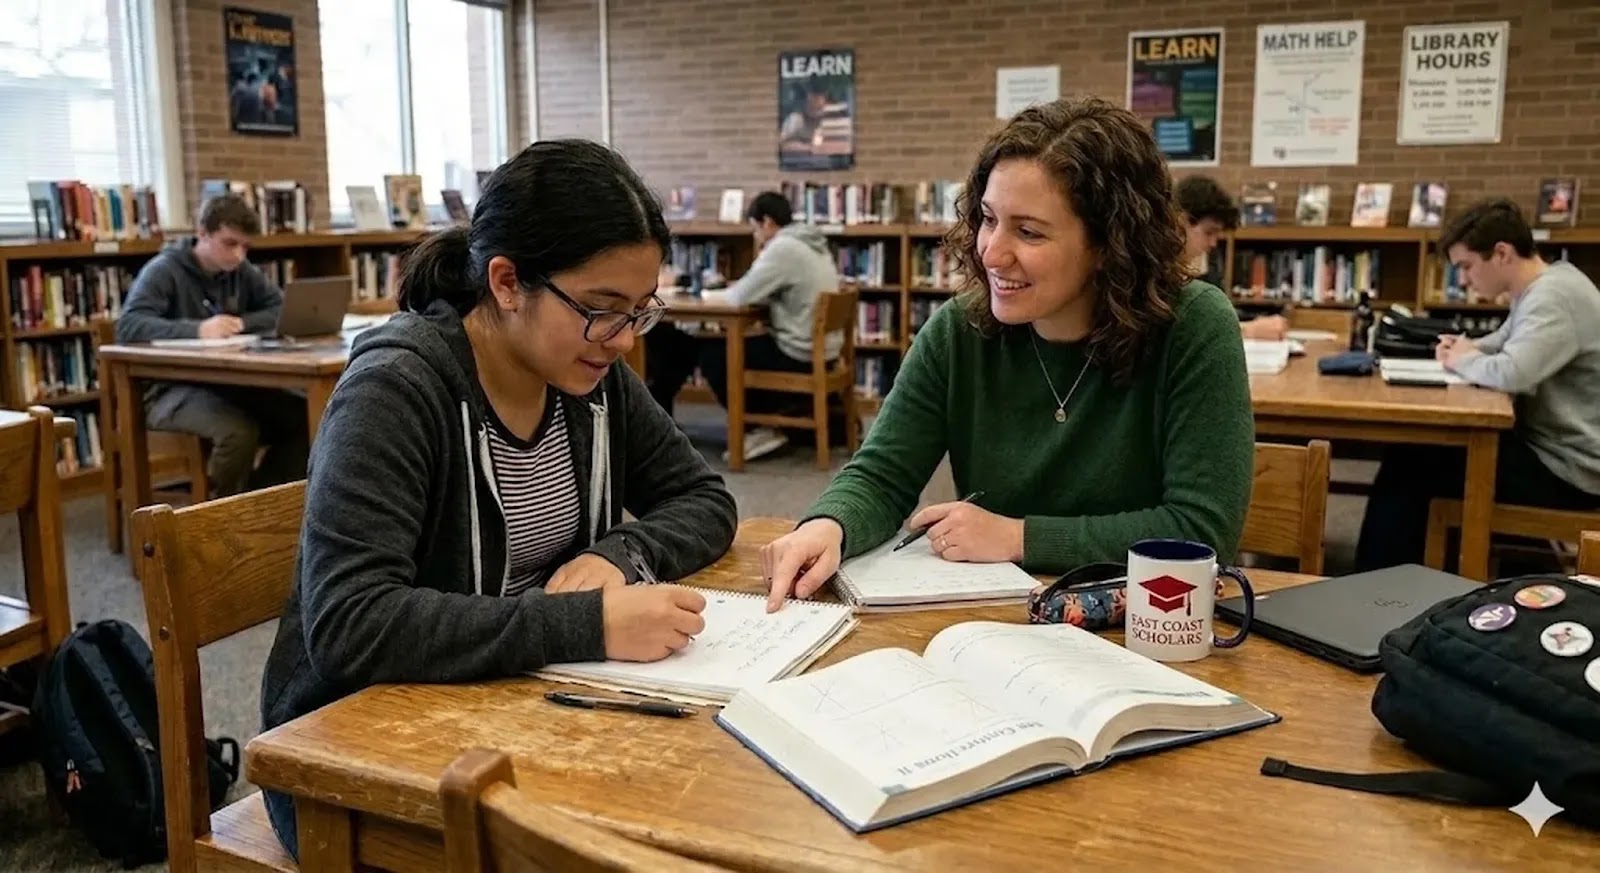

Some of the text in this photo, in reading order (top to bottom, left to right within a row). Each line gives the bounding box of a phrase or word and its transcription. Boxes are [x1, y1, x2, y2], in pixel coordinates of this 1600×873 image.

[1135, 37, 1217, 60] LEARN
[1263, 30, 1358, 51] MATH HELP
[1411, 31, 1499, 51] LIBRARY
[781, 55, 852, 78] LEARN
[1416, 51, 1491, 70] HOURS
[1131, 613, 1204, 632] EAST COAST
[1131, 627, 1203, 645] SCHOLARS
